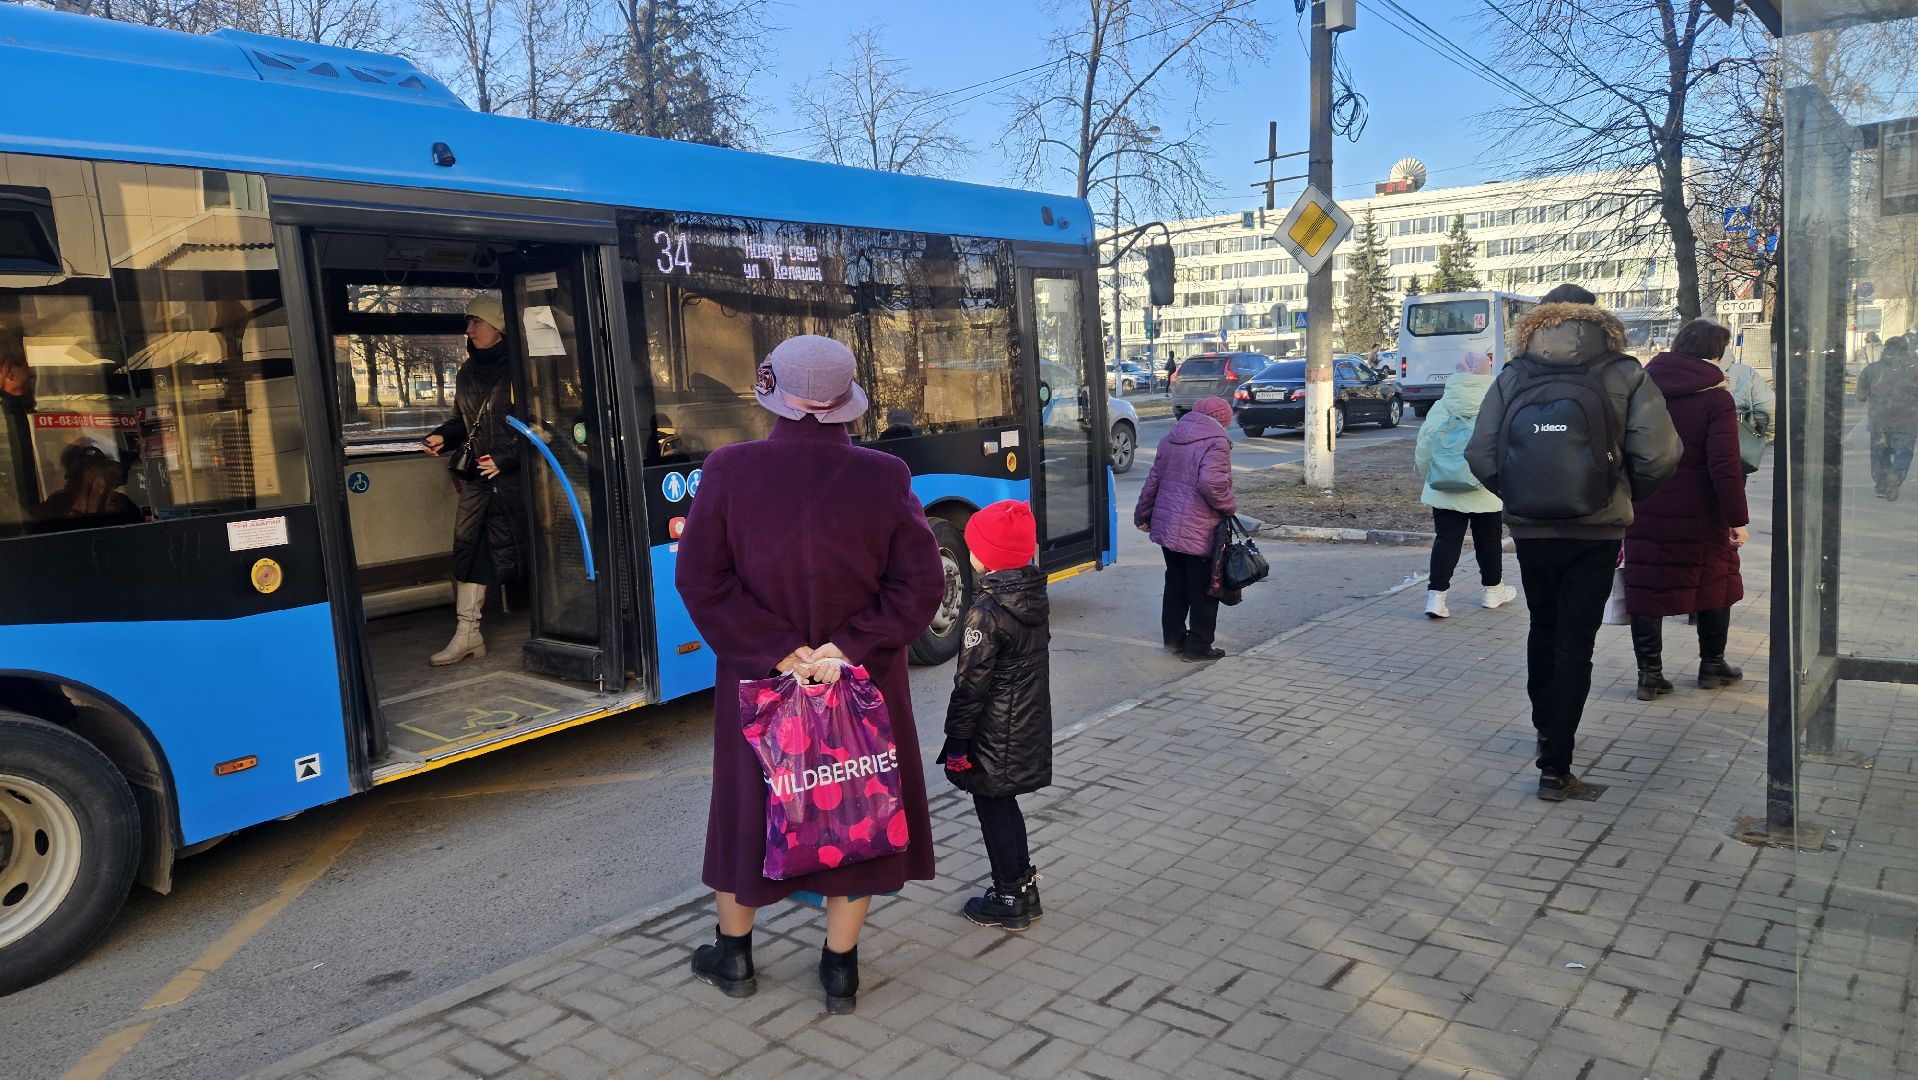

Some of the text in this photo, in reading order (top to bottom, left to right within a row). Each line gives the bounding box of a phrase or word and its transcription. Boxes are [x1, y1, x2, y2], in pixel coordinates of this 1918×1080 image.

[654, 230, 692, 275] 34
[744, 236, 818, 262] Новое село
[1722, 301, 1755, 311] СТОП
[1475, 315, 1485, 327] 14
[1541, 423, 1567, 432] ideco
